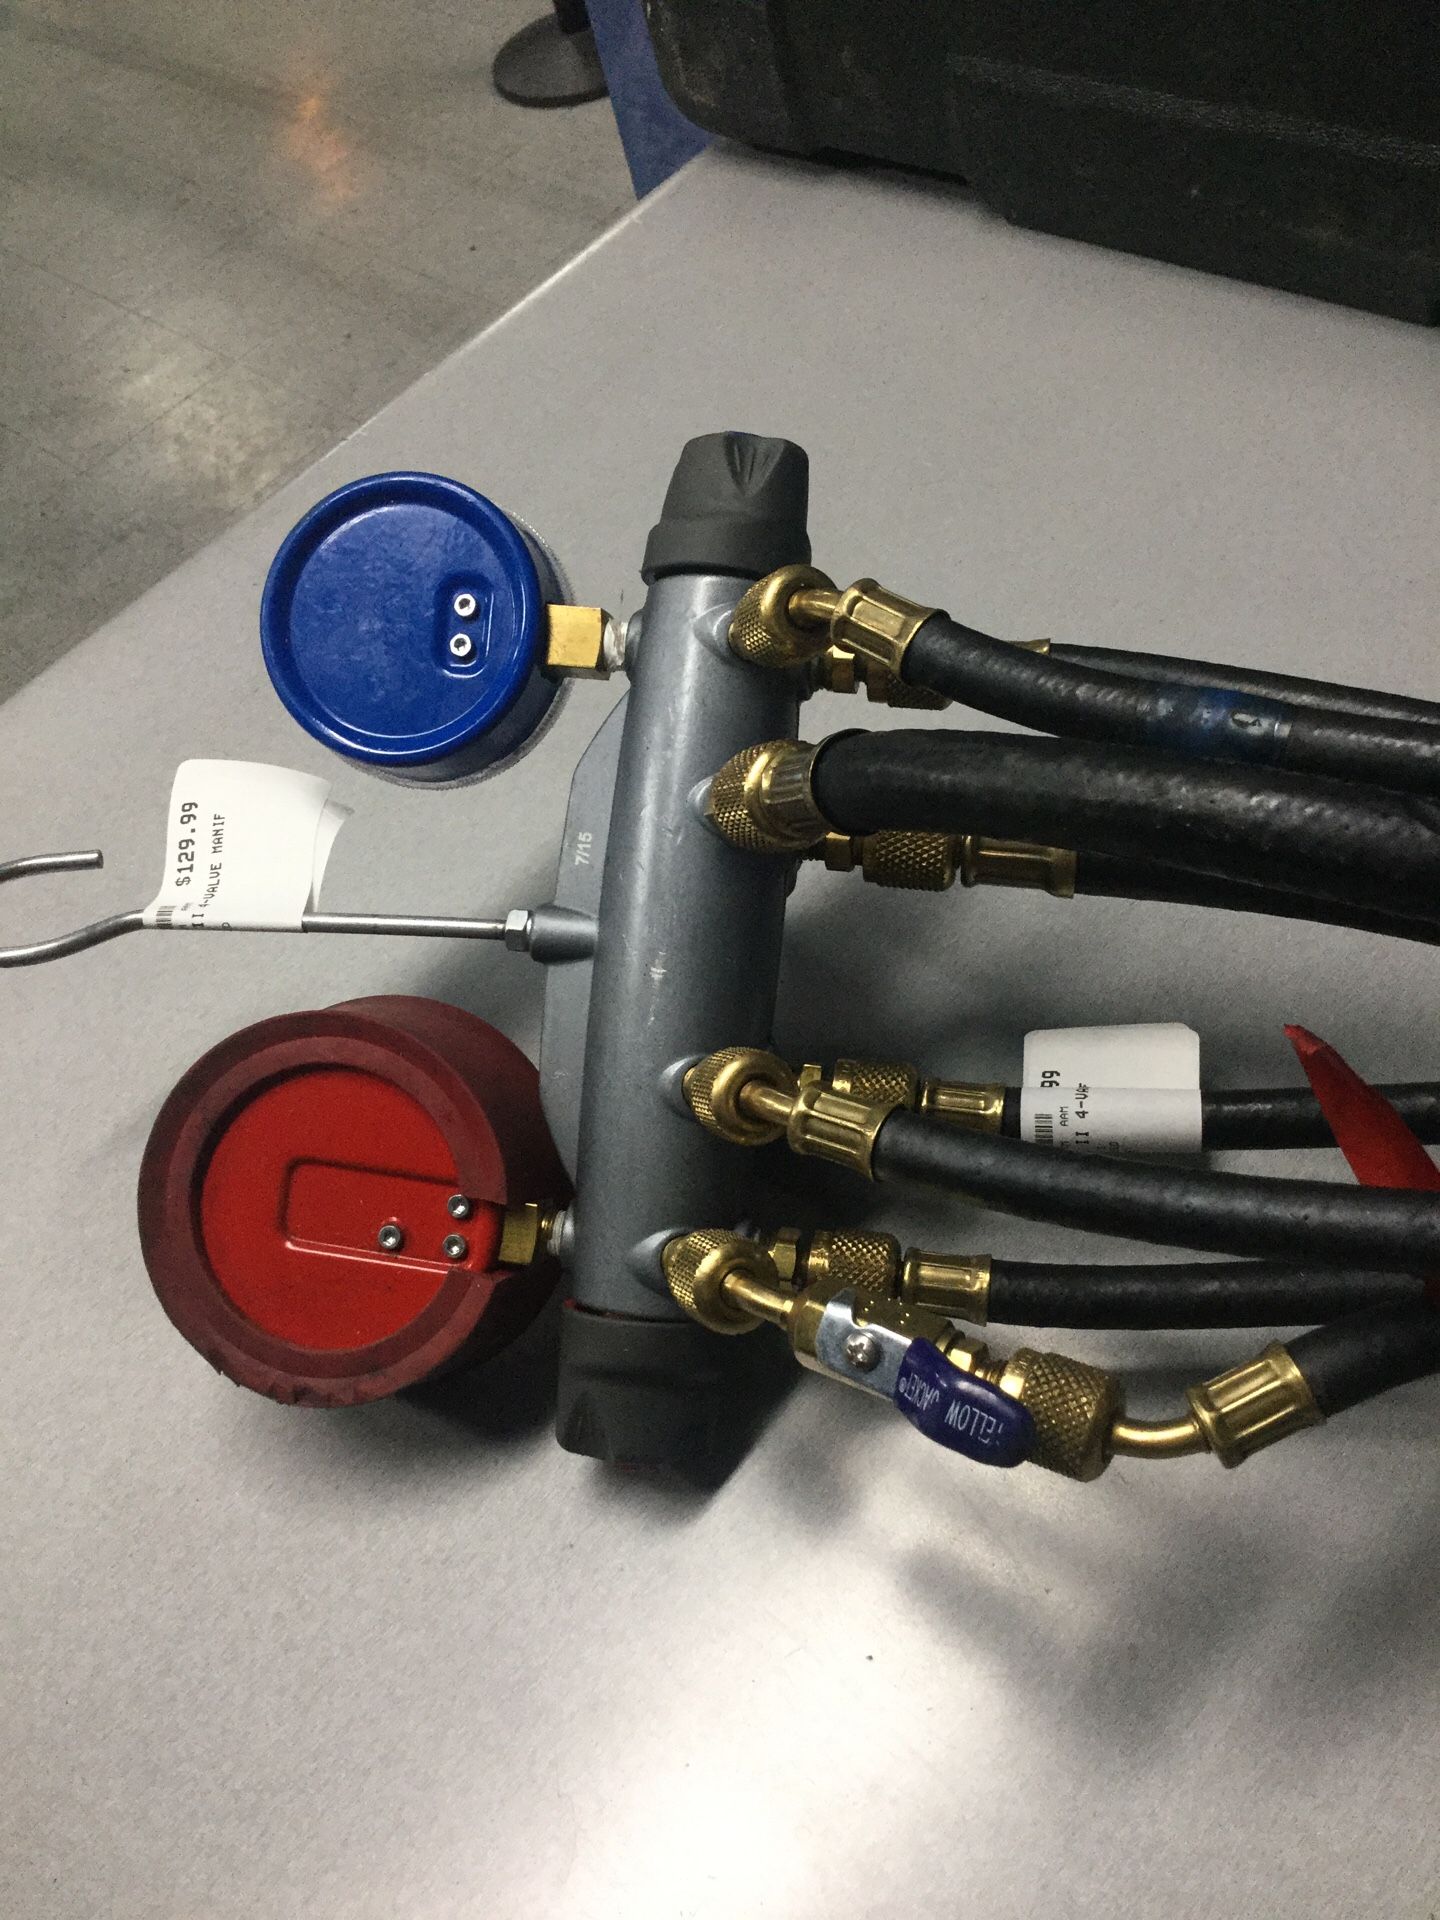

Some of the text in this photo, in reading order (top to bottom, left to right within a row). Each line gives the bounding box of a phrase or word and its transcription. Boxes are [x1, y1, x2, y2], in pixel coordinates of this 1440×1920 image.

[175, 802, 198, 887] $129.99
[211, 813, 225, 854] MANIF
[575, 832, 592, 865] 7/15
[1060, 1106, 1069, 1126] AAM
